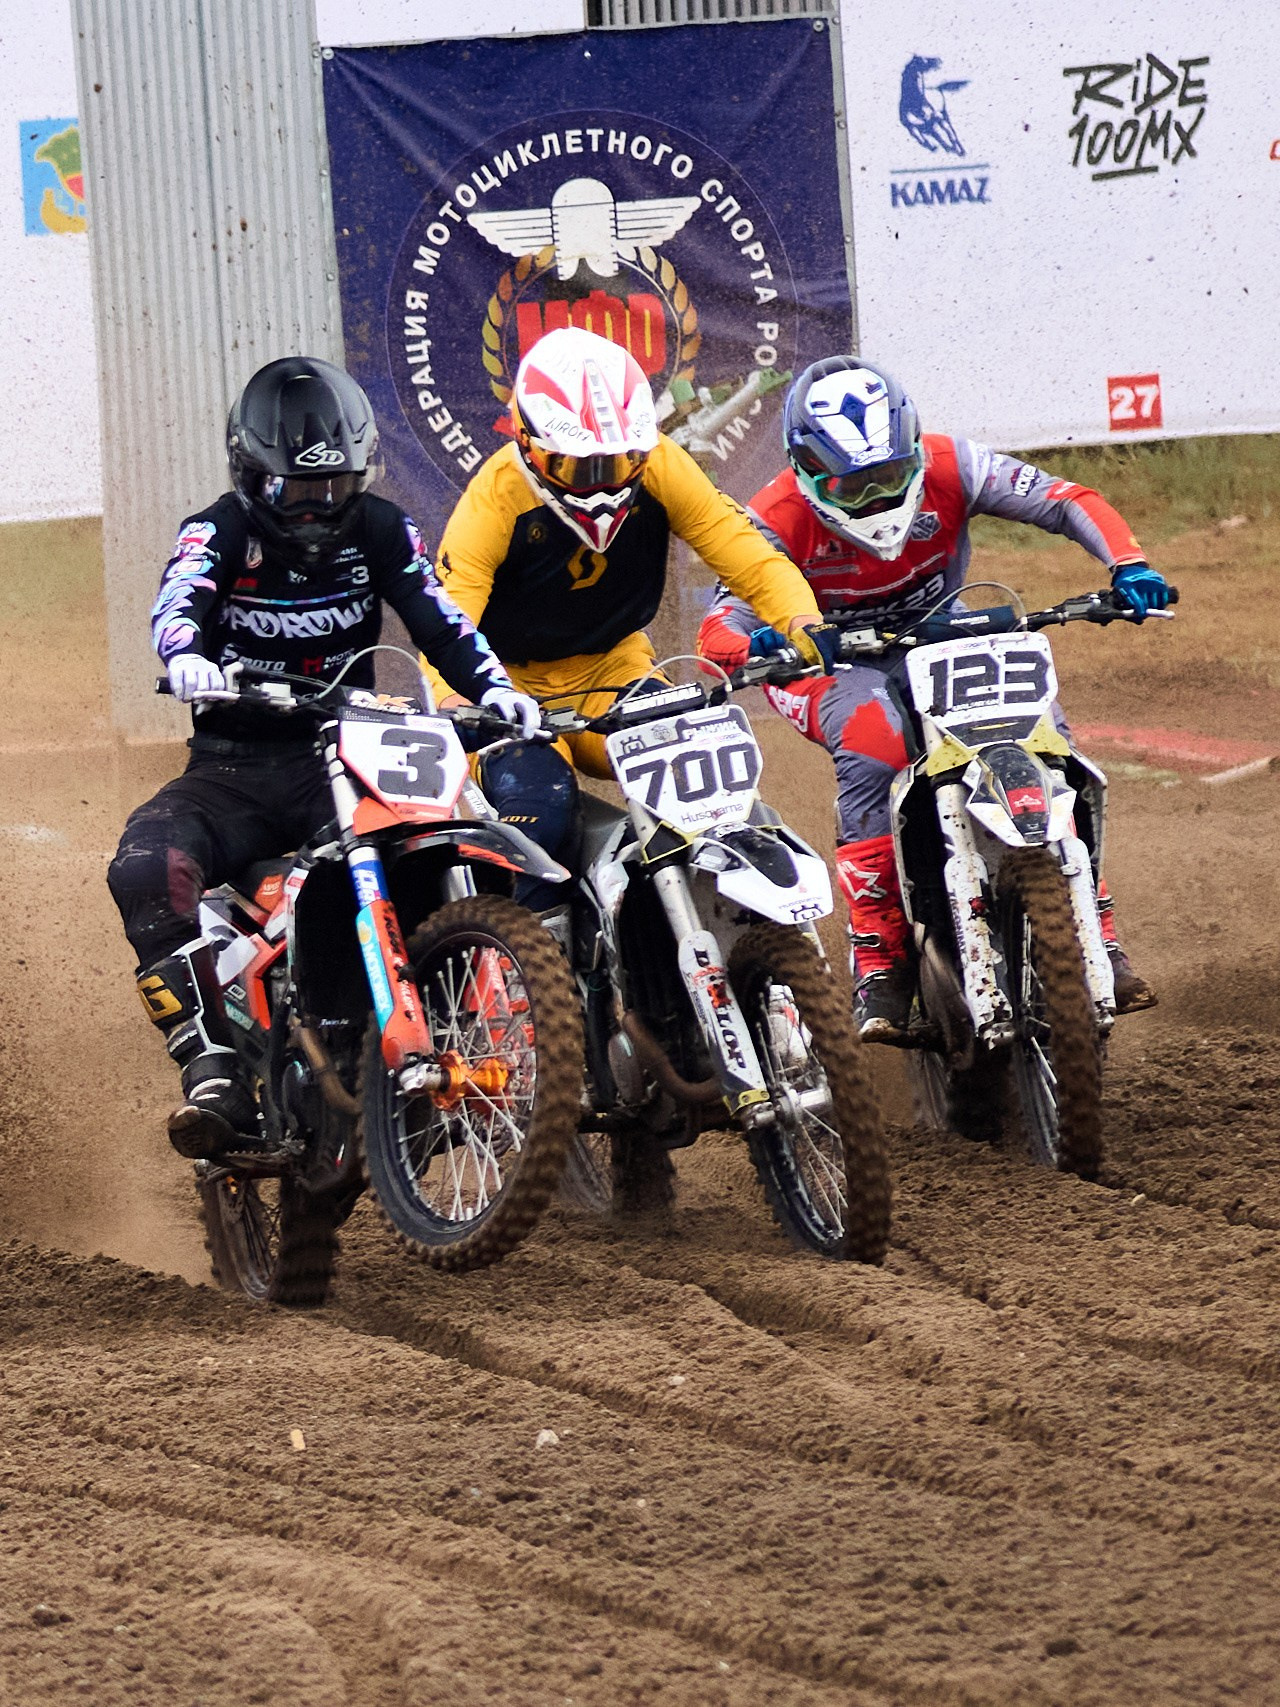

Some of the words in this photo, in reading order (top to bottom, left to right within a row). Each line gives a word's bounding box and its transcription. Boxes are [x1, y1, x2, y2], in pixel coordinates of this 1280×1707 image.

[413, 128, 693, 276] МОТОЦИКЛЕТНОГО
[890, 177, 991, 208] KAMAZ
[700, 178, 778, 305] СПОРТА
[404, 289, 482, 473] ЕДЕРАЦИЯ
[1110, 385, 1160, 420] 27
[351, 565, 370, 584] 3
[929, 650, 1050, 717] 123
[377, 727, 448, 799] 3
[625, 742, 758, 811] 700
